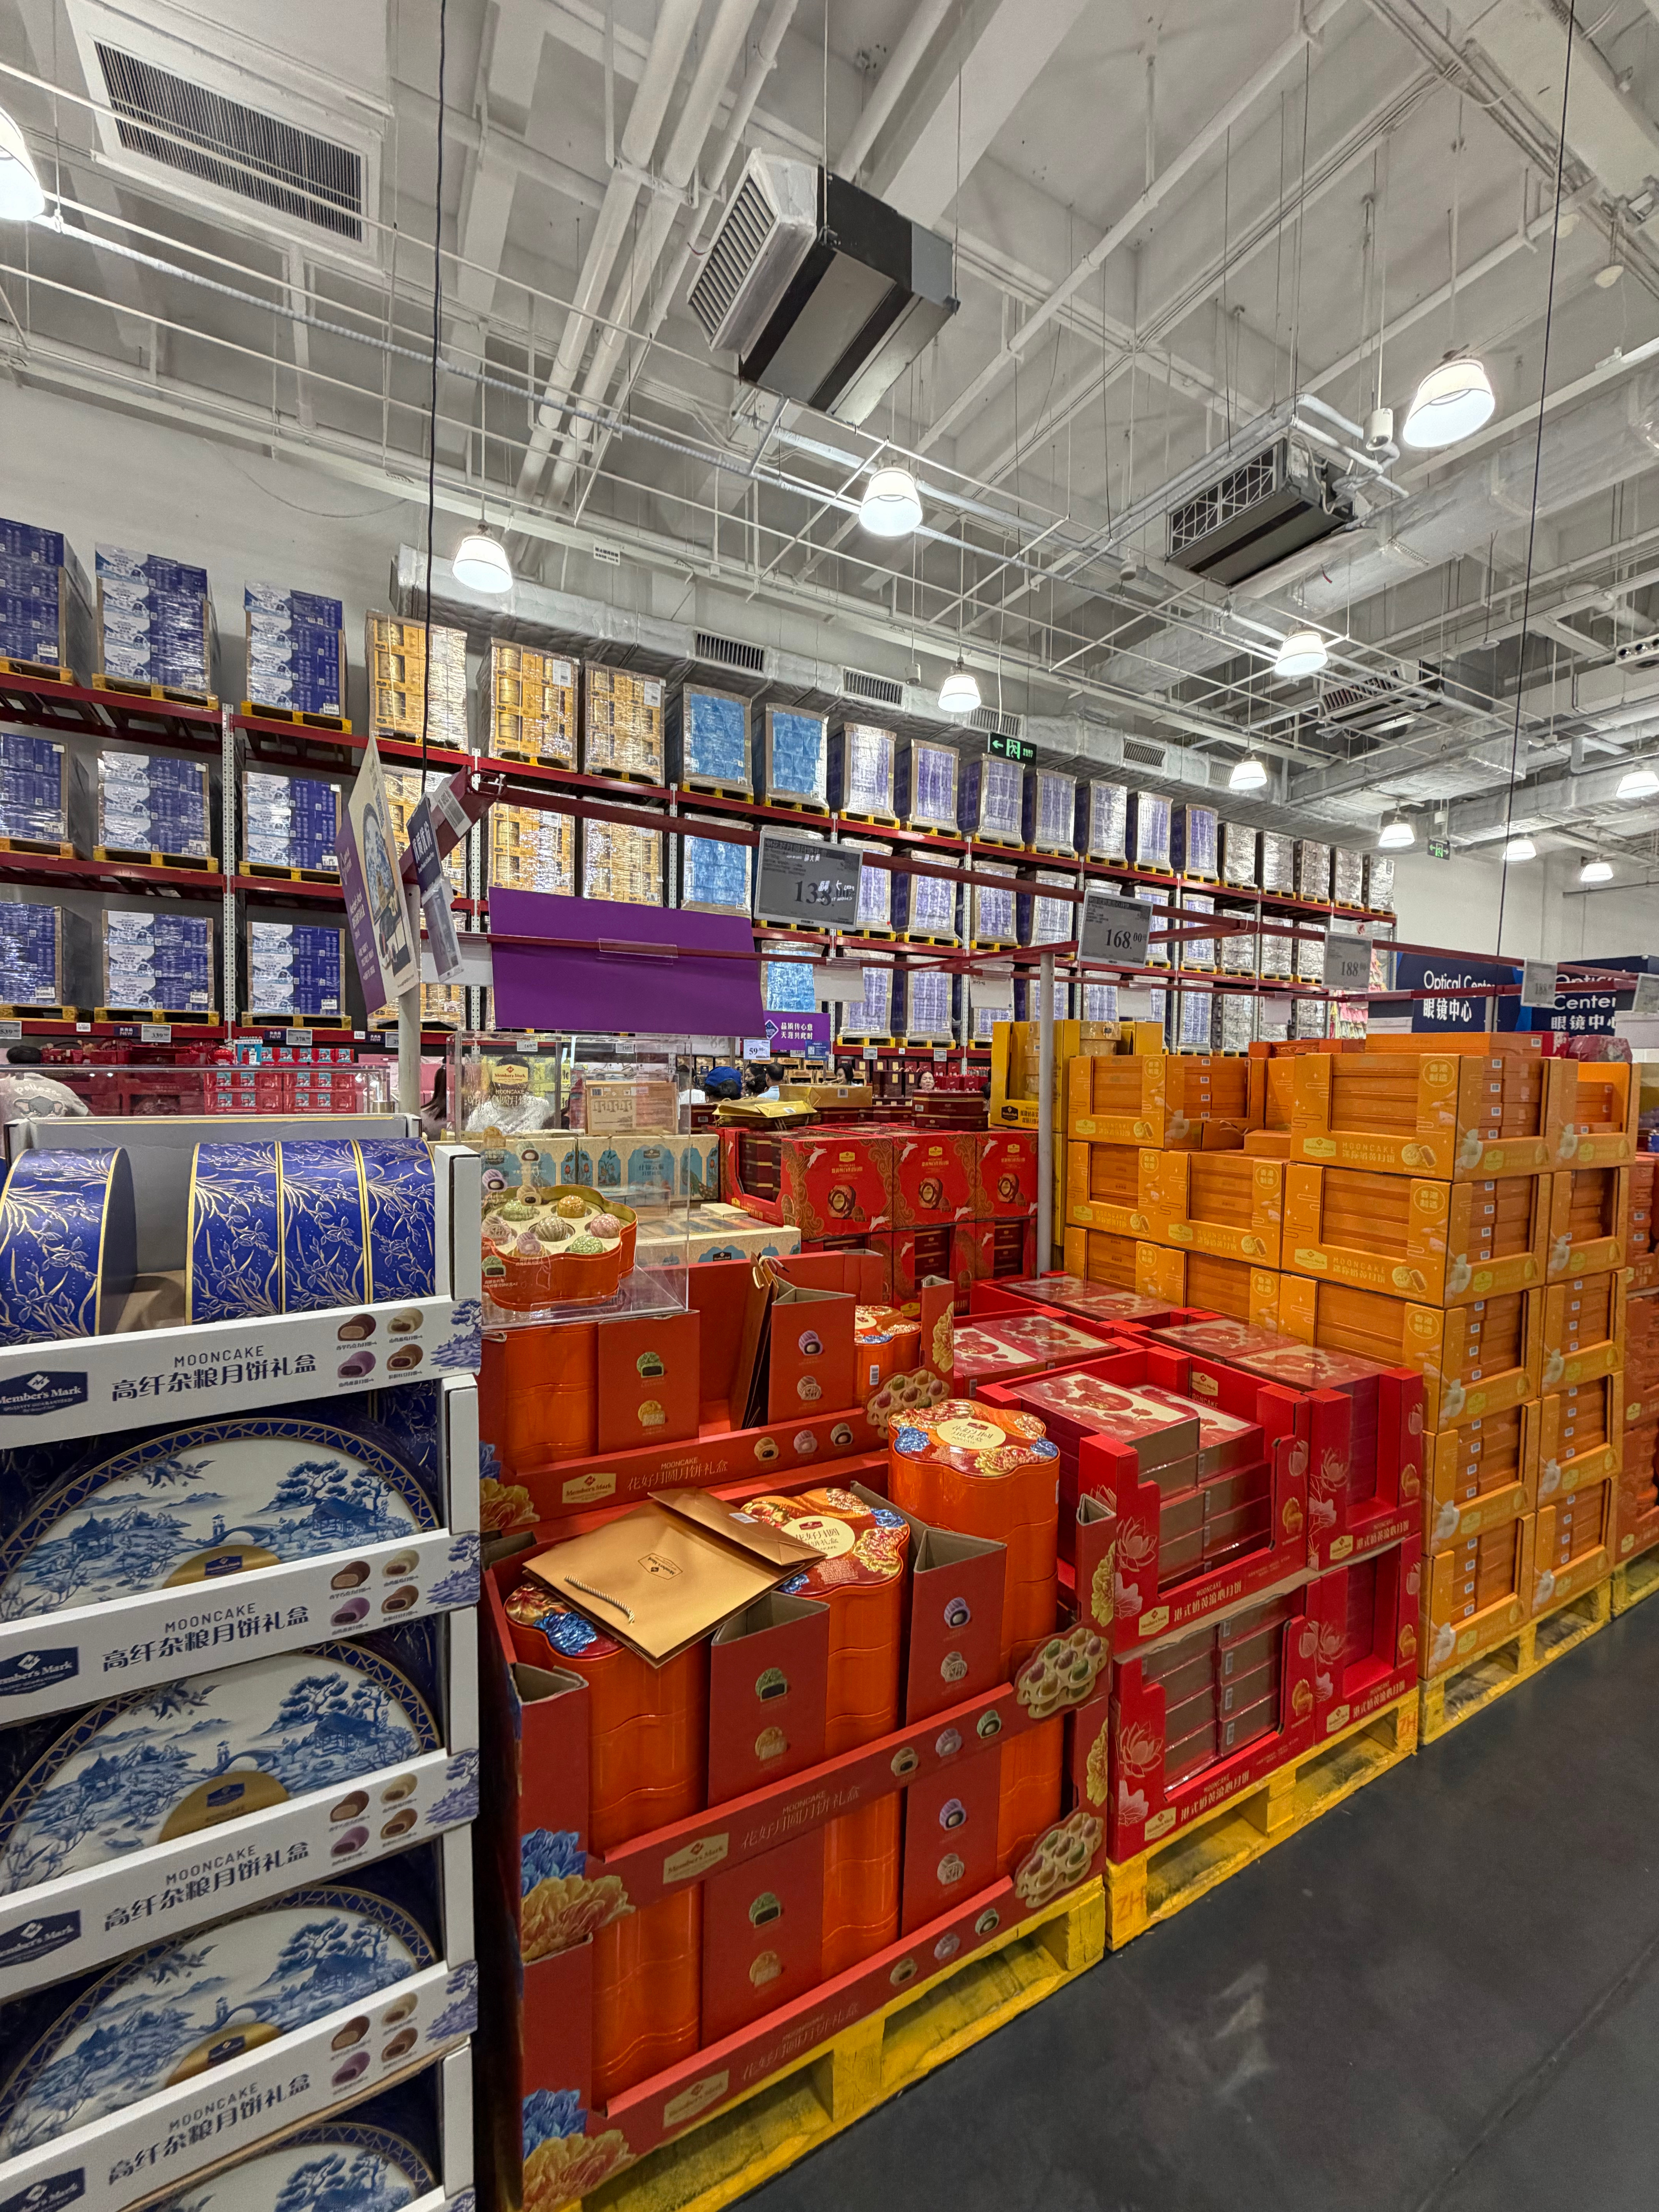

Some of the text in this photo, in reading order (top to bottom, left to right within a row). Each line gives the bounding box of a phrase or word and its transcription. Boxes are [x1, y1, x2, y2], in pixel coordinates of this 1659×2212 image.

[1424, 970, 1461, 990] Optical
[1423, 998, 1472, 1022] 眼镜中心
[1342, 1141, 1395, 1153] MOONCAKE
[1333, 1257, 1385, 1274] MOONCAKE
[174, 1345, 265, 1368] MOONCAKE
[111, 1354, 317, 1401] 高纤杂粮月饼礼盒
[50, 1385, 82, 1397] Mark
[627, 1460, 728, 1491] 花好月圆月饼礼盒
[661, 1457, 698, 1470] MOONCAKE
[1196, 1581, 1222, 1597] MOONCAKE
[165, 1602, 256, 1633] MOONCAKE
[102, 1606, 309, 1672] 高纤杂粮月饼礼盒
[783, 1790, 826, 1814] MOONCAKE
[166, 1844, 256, 1885] MOONCAKE
[105, 1841, 309, 1932] 高纤杂粮月饼礼盒
[169, 2081, 259, 2132] MOONCAKE
[109, 2073, 310, 2185] 高纤杂粮月饼礼盒
